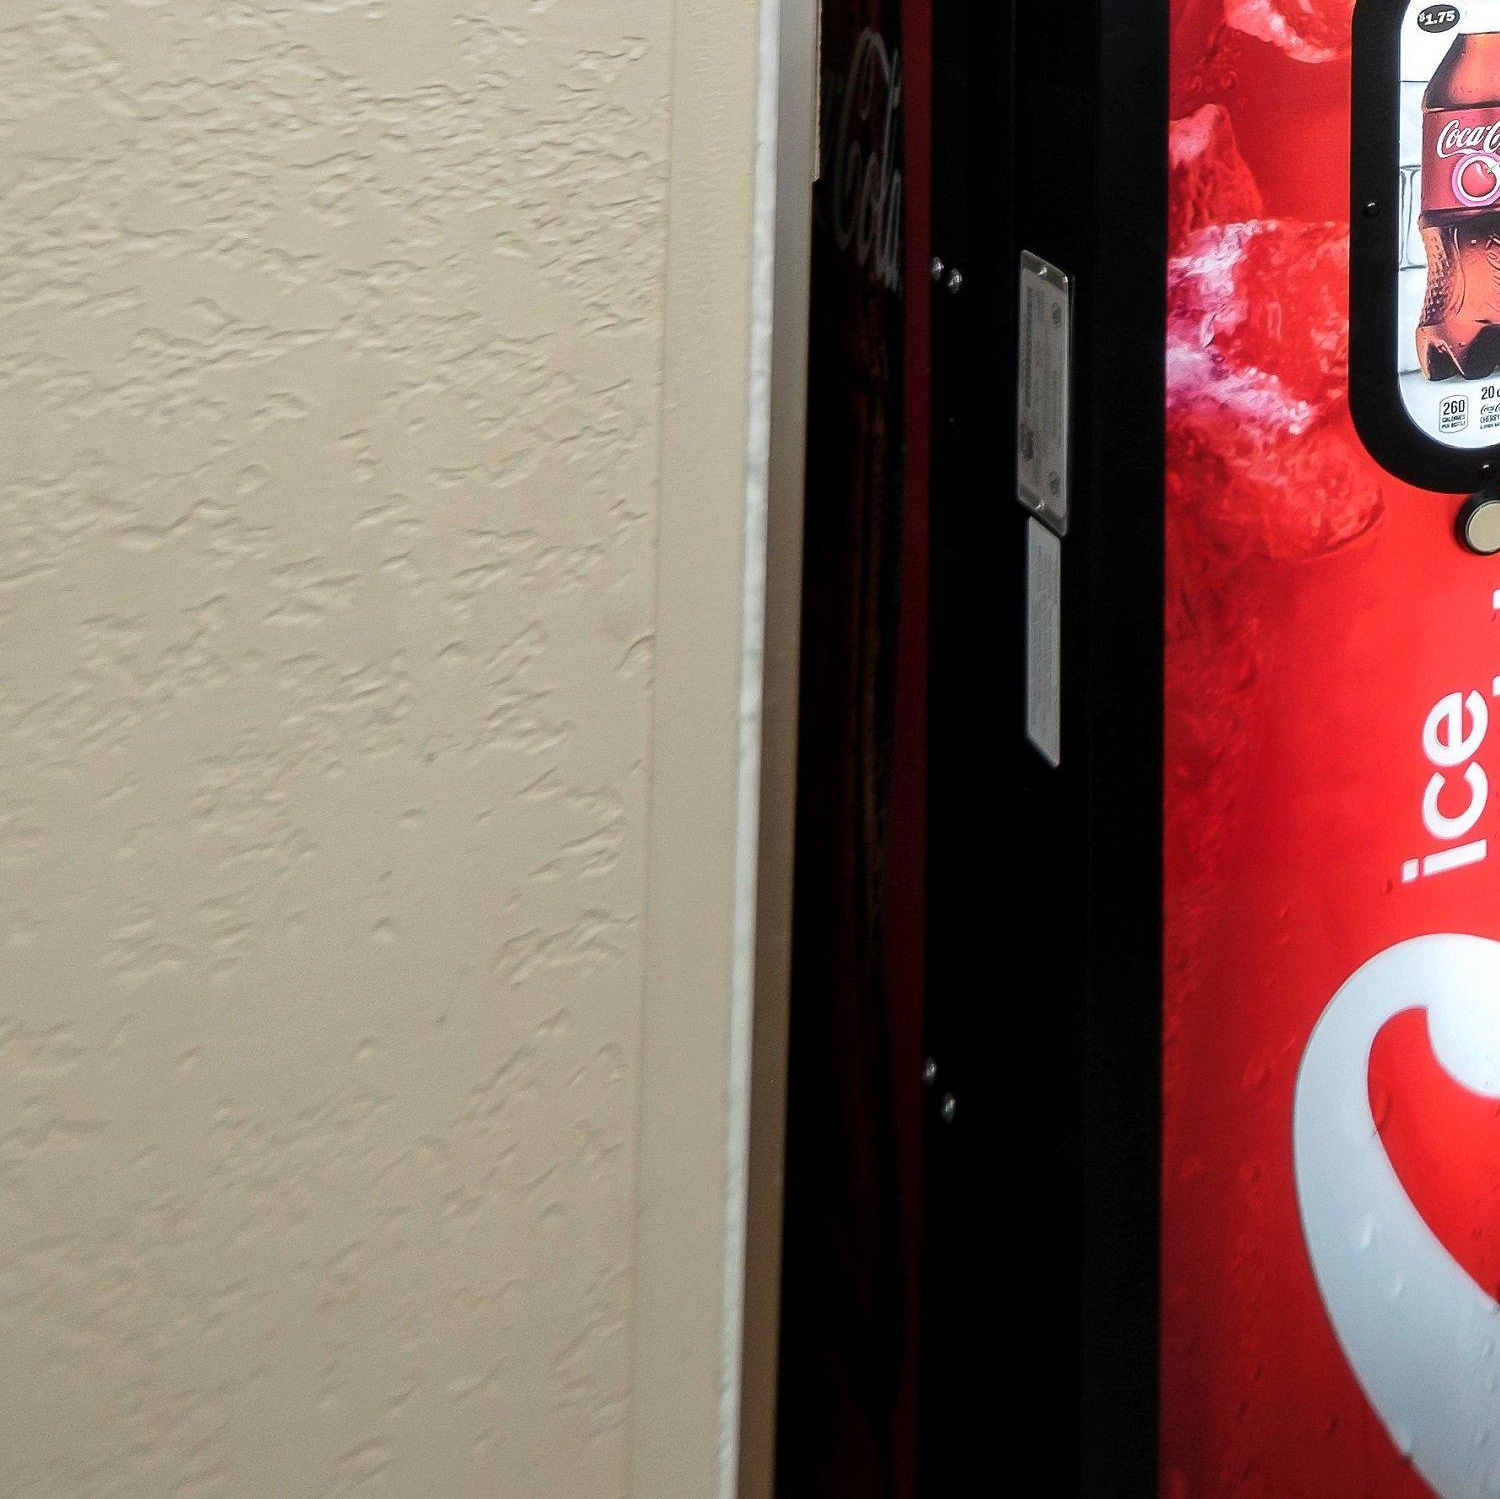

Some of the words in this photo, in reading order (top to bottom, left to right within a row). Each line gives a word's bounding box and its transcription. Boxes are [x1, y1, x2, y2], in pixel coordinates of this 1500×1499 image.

[1418, 10, 1455, 26] $1.75
[1481, 385, 1495, 400] 20
[1443, 399, 1465, 416] 260
[1401, 689, 1489, 885] ice
